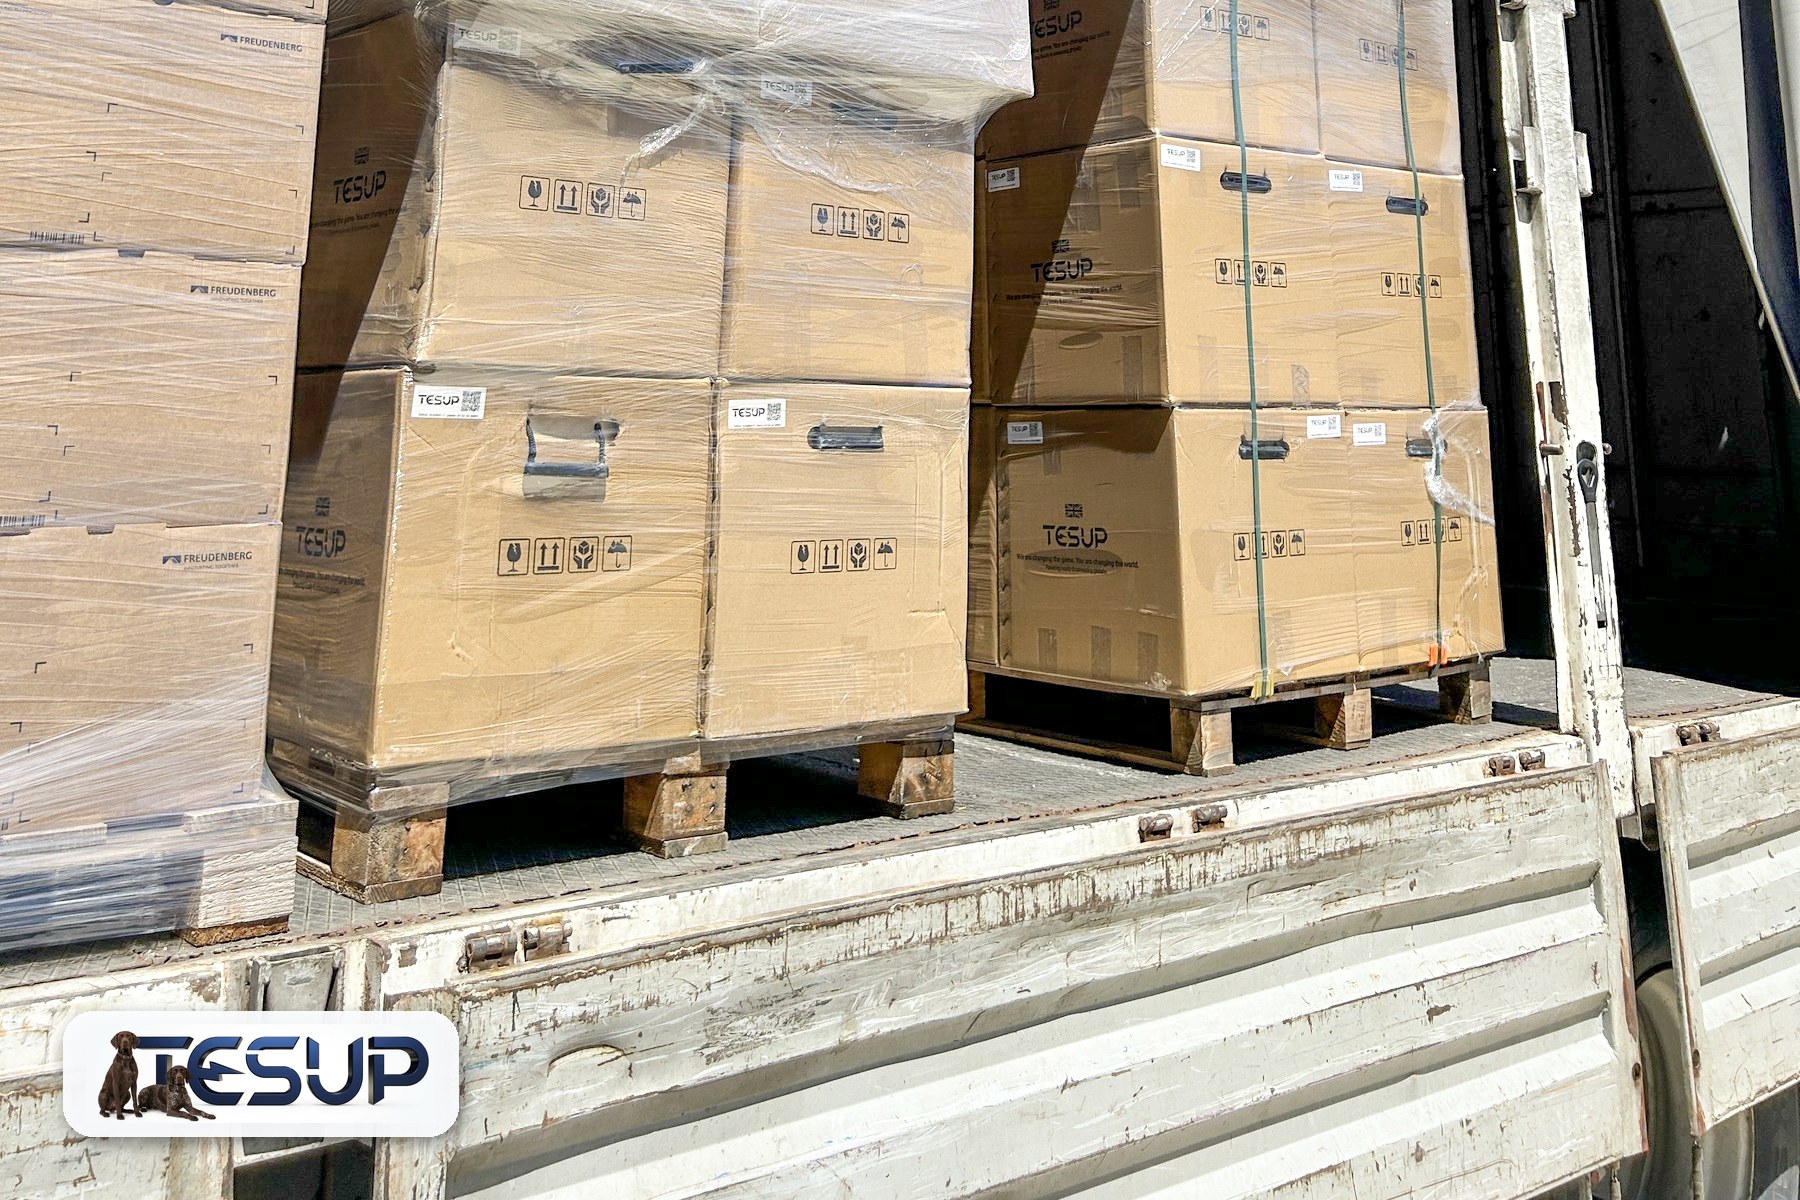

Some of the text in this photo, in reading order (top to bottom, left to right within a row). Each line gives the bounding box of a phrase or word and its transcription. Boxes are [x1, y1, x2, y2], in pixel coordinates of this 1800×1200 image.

[1031, 10, 1082, 39] ESUP
[458, 27, 498, 42] TESUP
[240, 36, 303, 52] FREUDENBERG
[764, 80, 794, 93] TESUP
[333, 169, 387, 204] TESUP
[1030, 257, 1093, 283] TESUP
[210, 286, 276, 297] FREUDENBERG
[418, 394, 460, 406] TESUP
[732, 407, 766, 418] TESUP
[295, 525, 346, 558] TESUP
[1042, 524, 1108, 549] TESUP
[183, 551, 252, 563] FREUDENBERG
